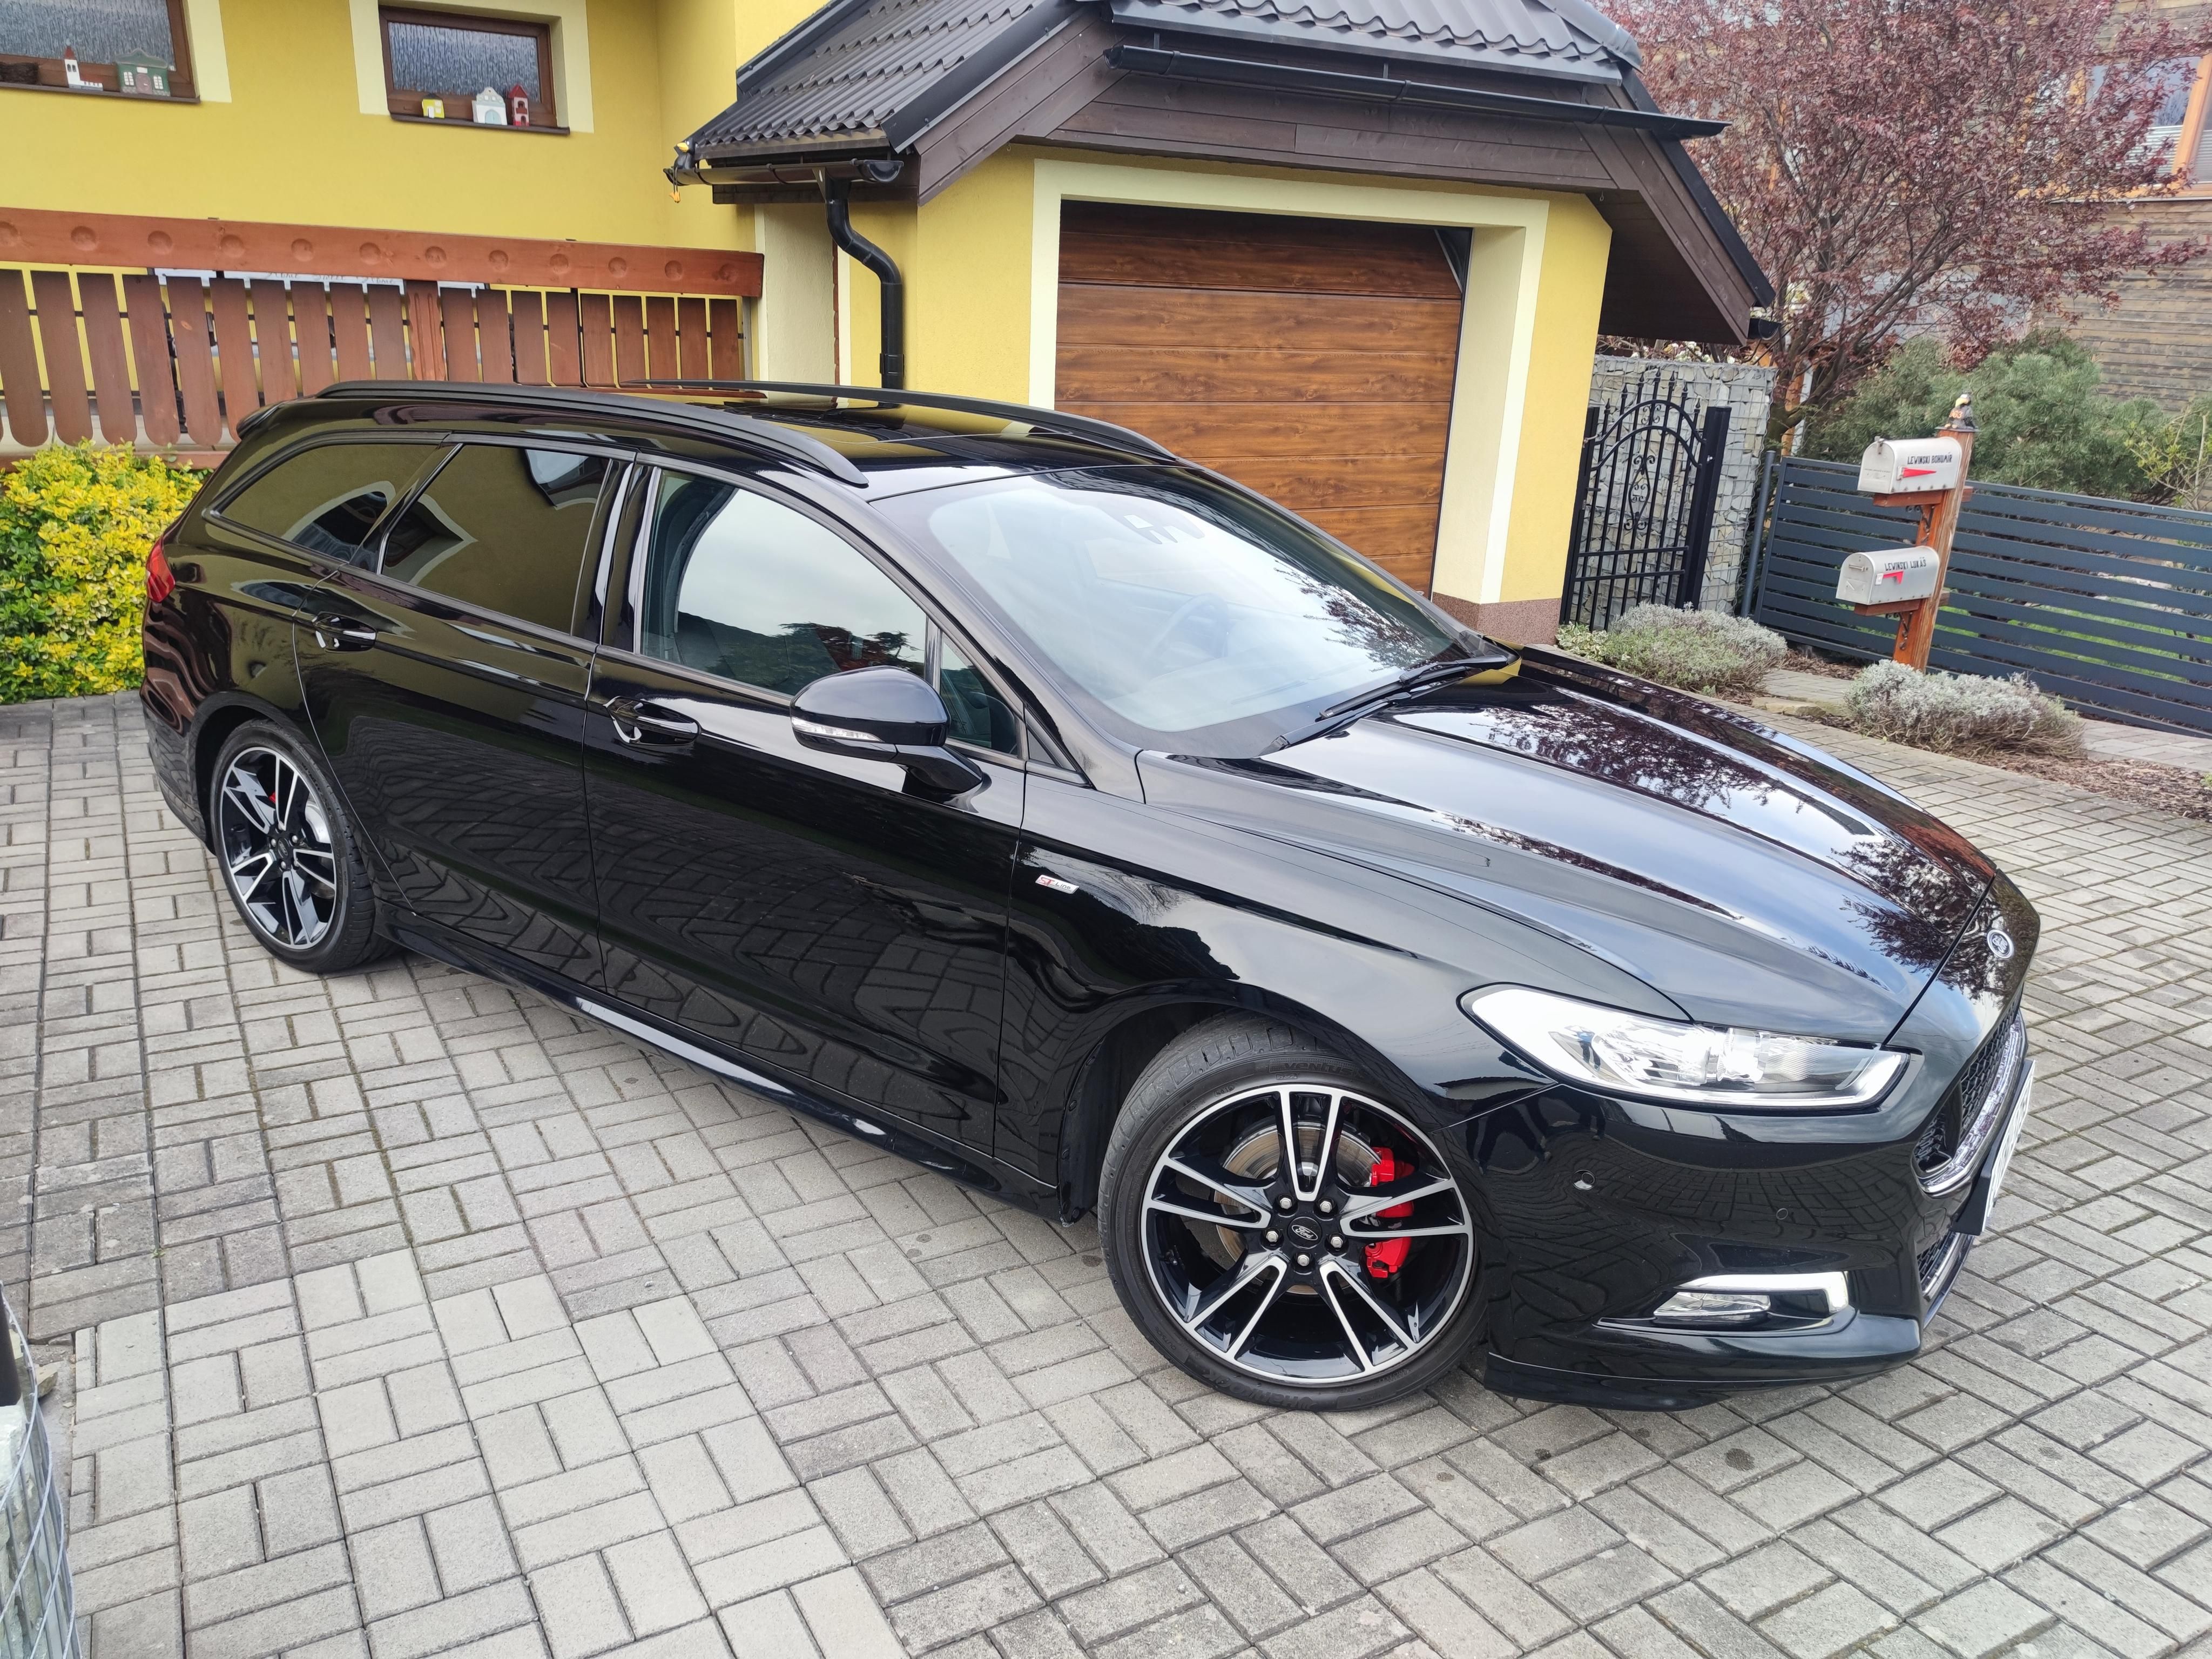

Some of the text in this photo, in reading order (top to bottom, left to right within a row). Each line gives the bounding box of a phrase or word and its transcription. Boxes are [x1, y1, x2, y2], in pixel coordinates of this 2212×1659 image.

[1038, 876, 1071, 890] ST Line
[1295, 1227, 1314, 1239] Ford
